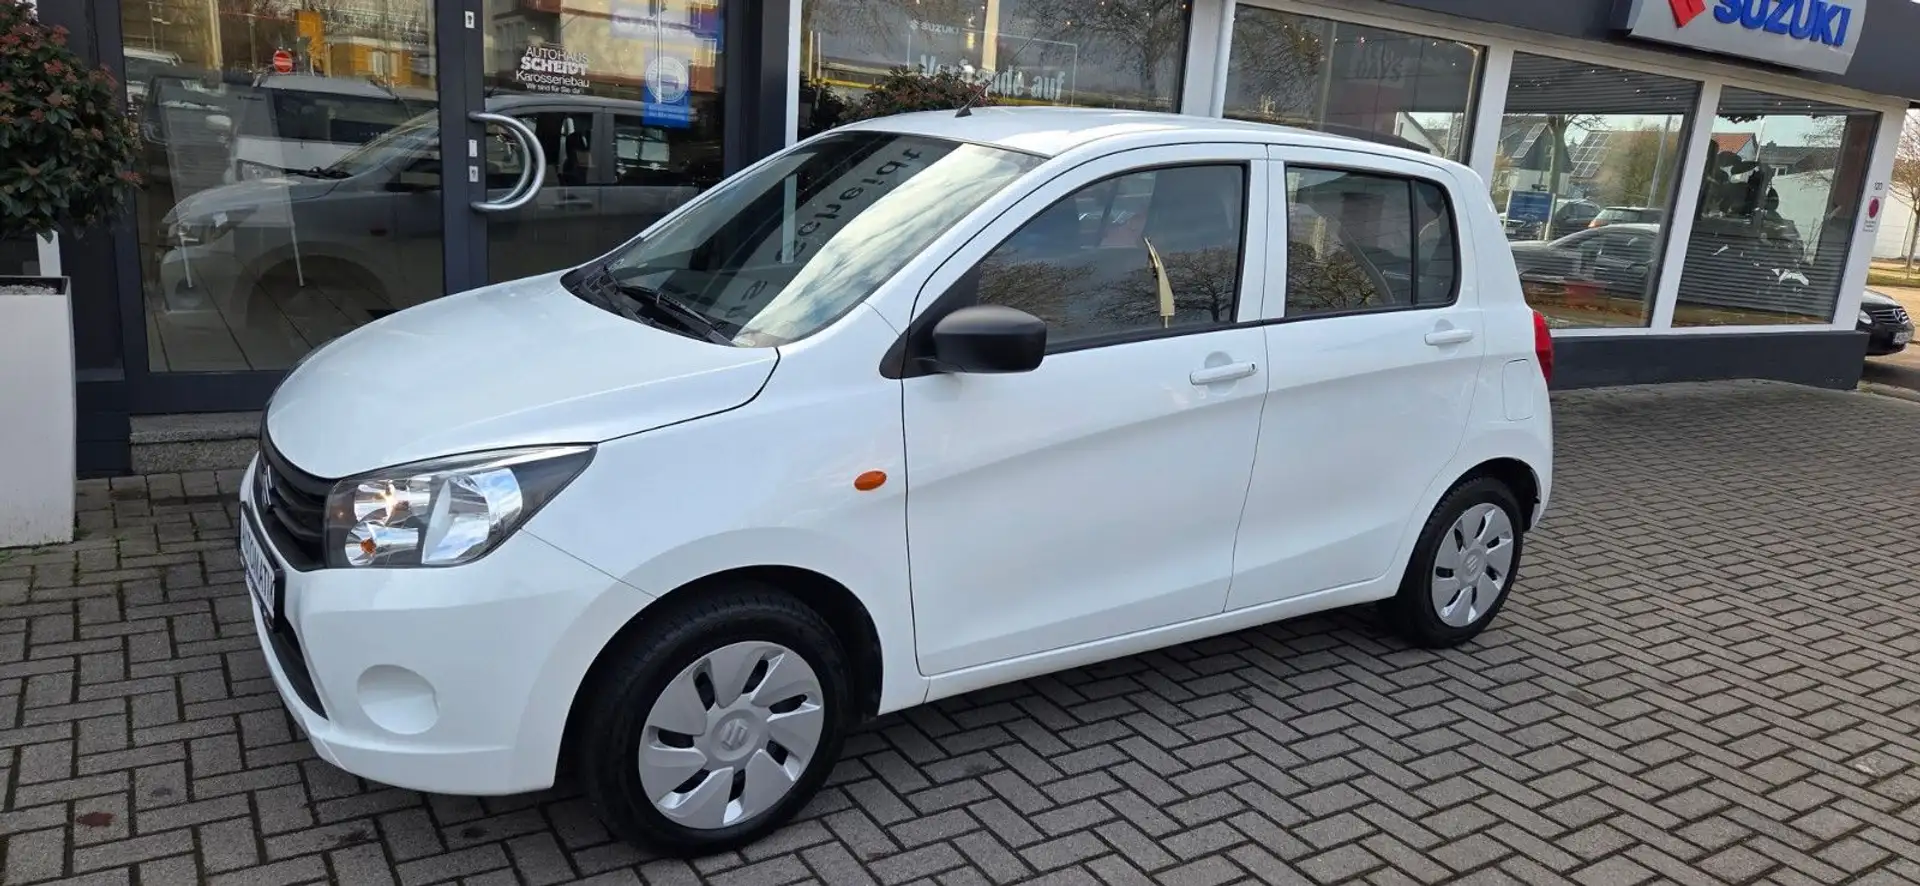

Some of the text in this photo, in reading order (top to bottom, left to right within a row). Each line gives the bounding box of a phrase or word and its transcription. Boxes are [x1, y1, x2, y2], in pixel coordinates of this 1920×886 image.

[921, 21, 959, 34] SUZUKI
[1713, 0, 1852, 47] SUZUKI
[525, 45, 589, 64] AUTOHAUS
[520, 56, 588, 76] SCHEIDT
[515, 69, 590, 87] Karosseriebau
[1031, 71, 1066, 100] auf
